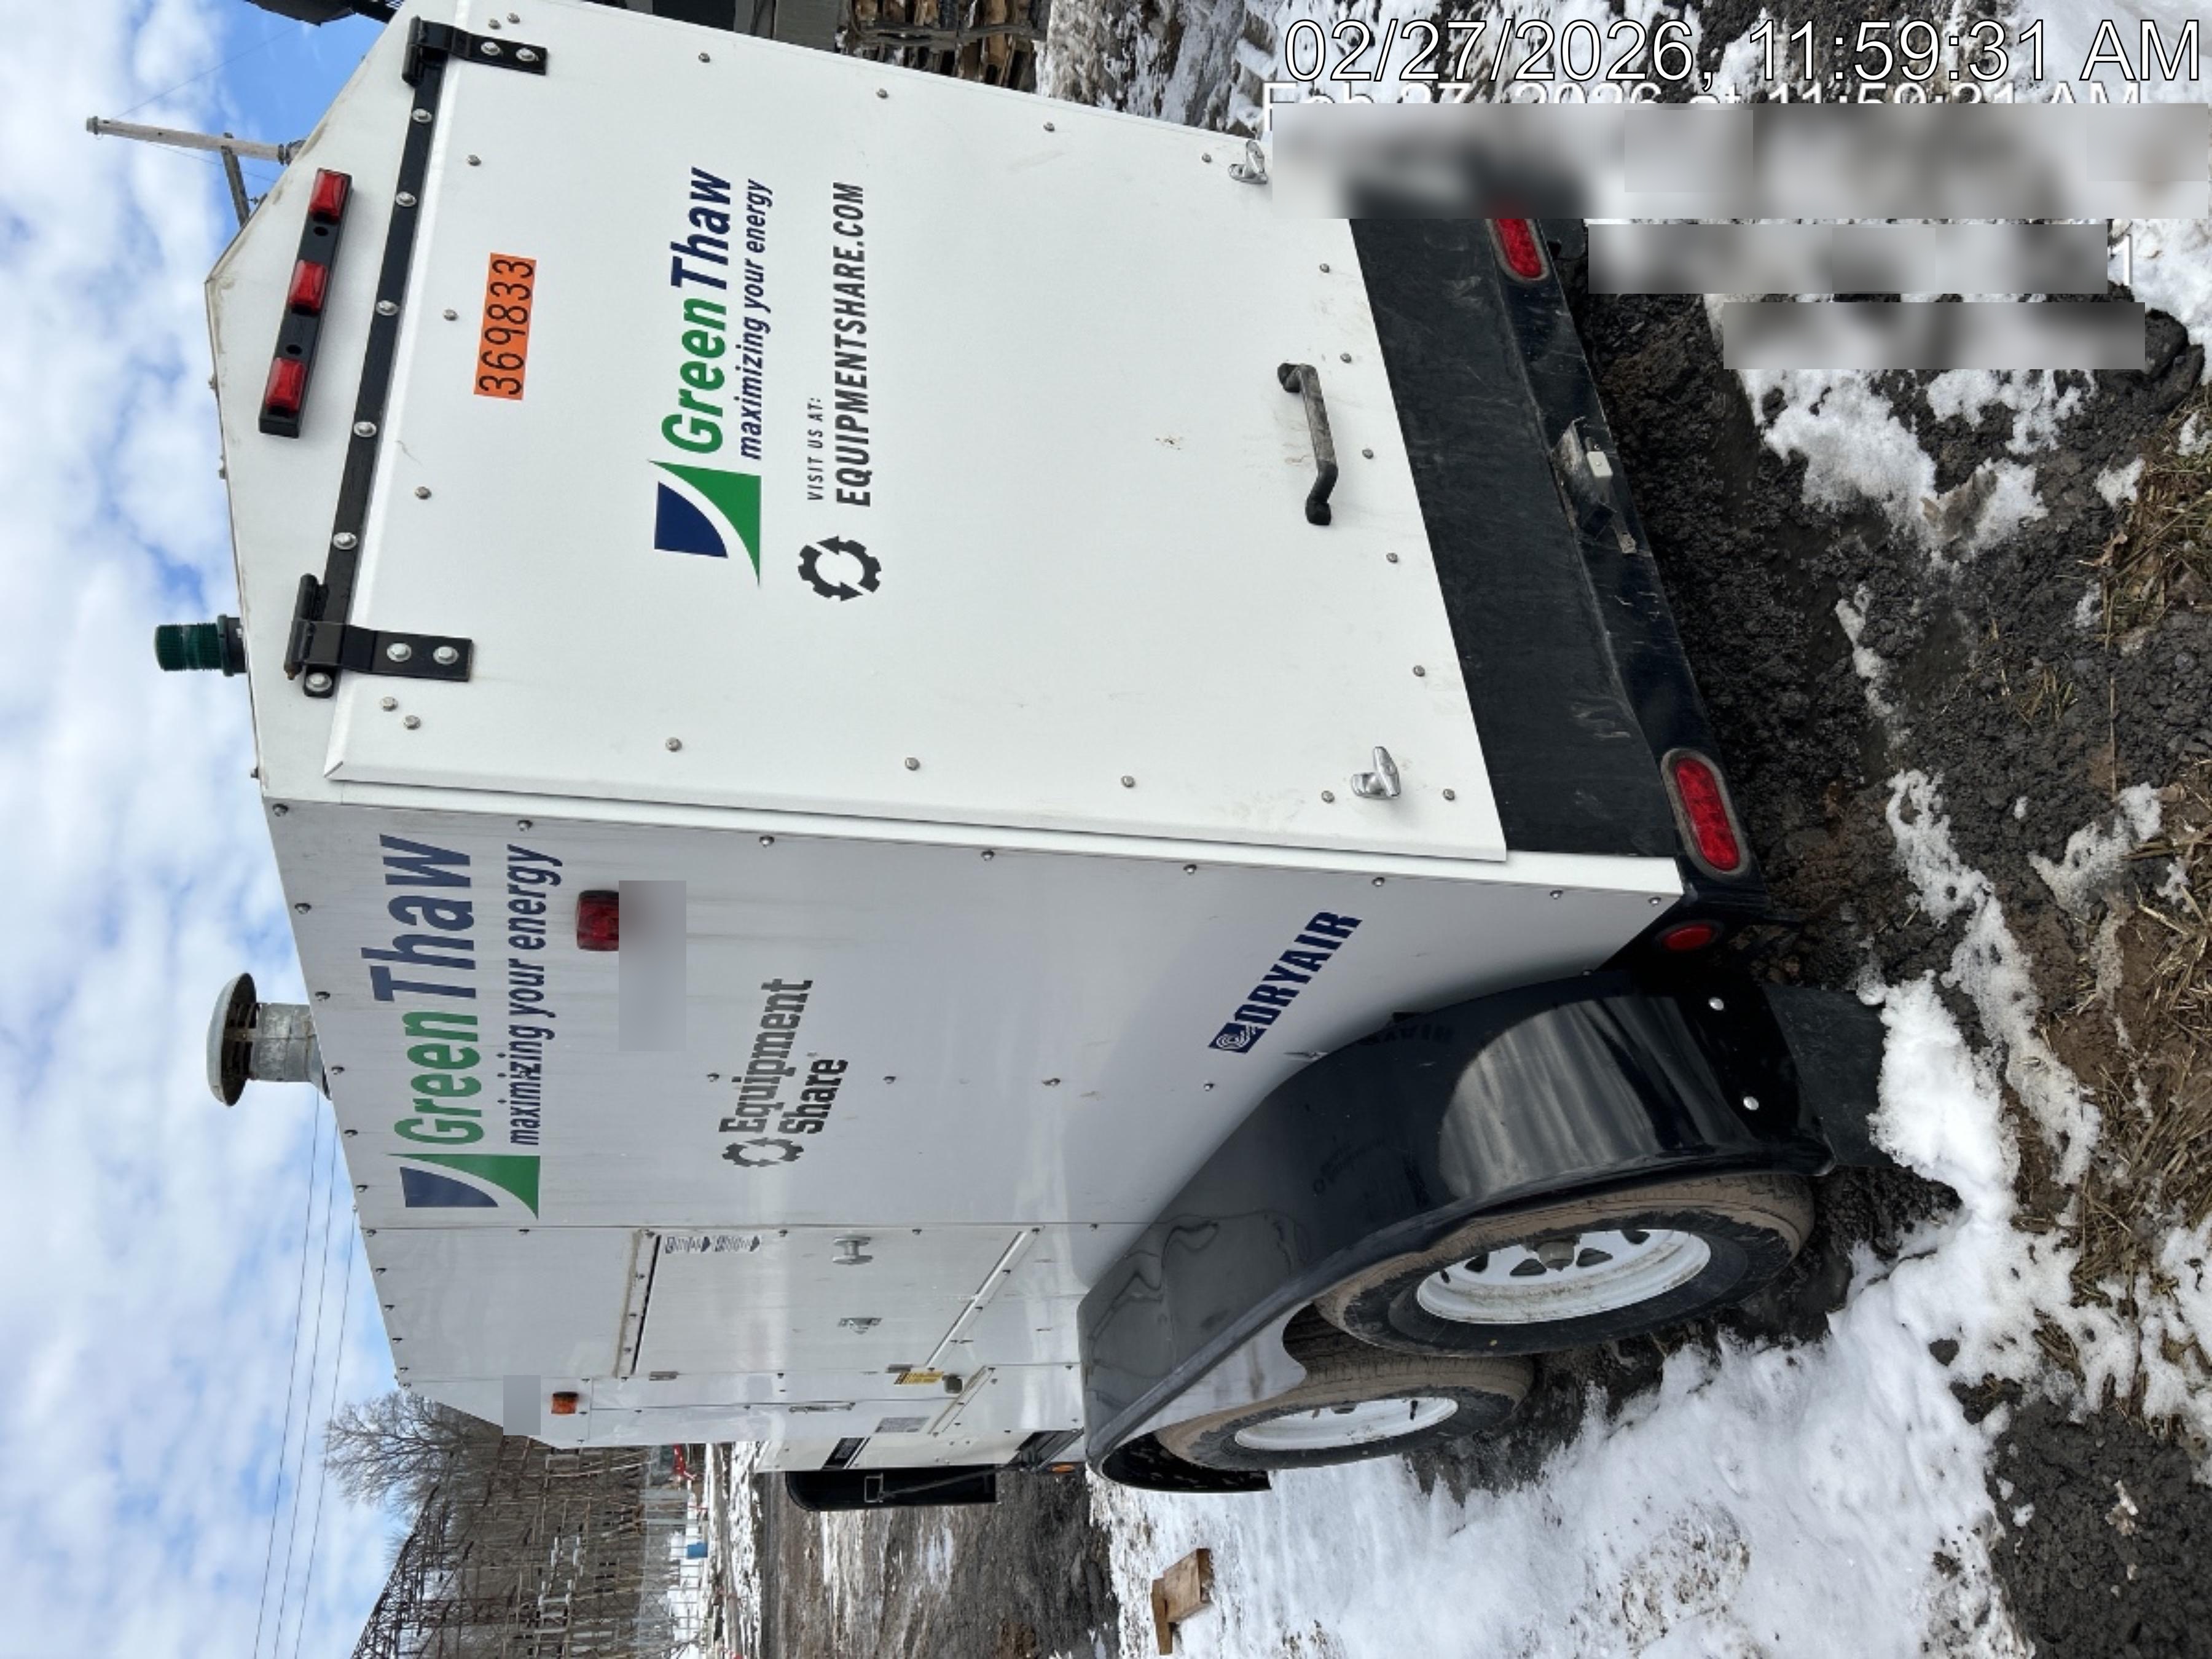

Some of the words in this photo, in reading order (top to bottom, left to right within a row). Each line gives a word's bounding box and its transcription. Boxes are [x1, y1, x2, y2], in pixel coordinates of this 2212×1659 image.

[744, 178, 773, 253] energy
[479, 259, 533, 394] 369833
[743, 258, 771, 312] your
[734, 316, 771, 460] maximizing
[833, 181, 873, 506] EQUIPMENTSHARE.COM
[807, 397, 823, 421] AT:
[807, 429, 823, 448] US
[807, 456, 823, 500] VISIT
[506, 843, 562, 949] energy
[508, 958, 556, 1017] your
[1233, 911, 1362, 1024] DRYAIR
[497, 1024, 555, 1145] maximizing
[718, 978, 813, 1133] Equipment
[777, 1059, 848, 1133] Share
